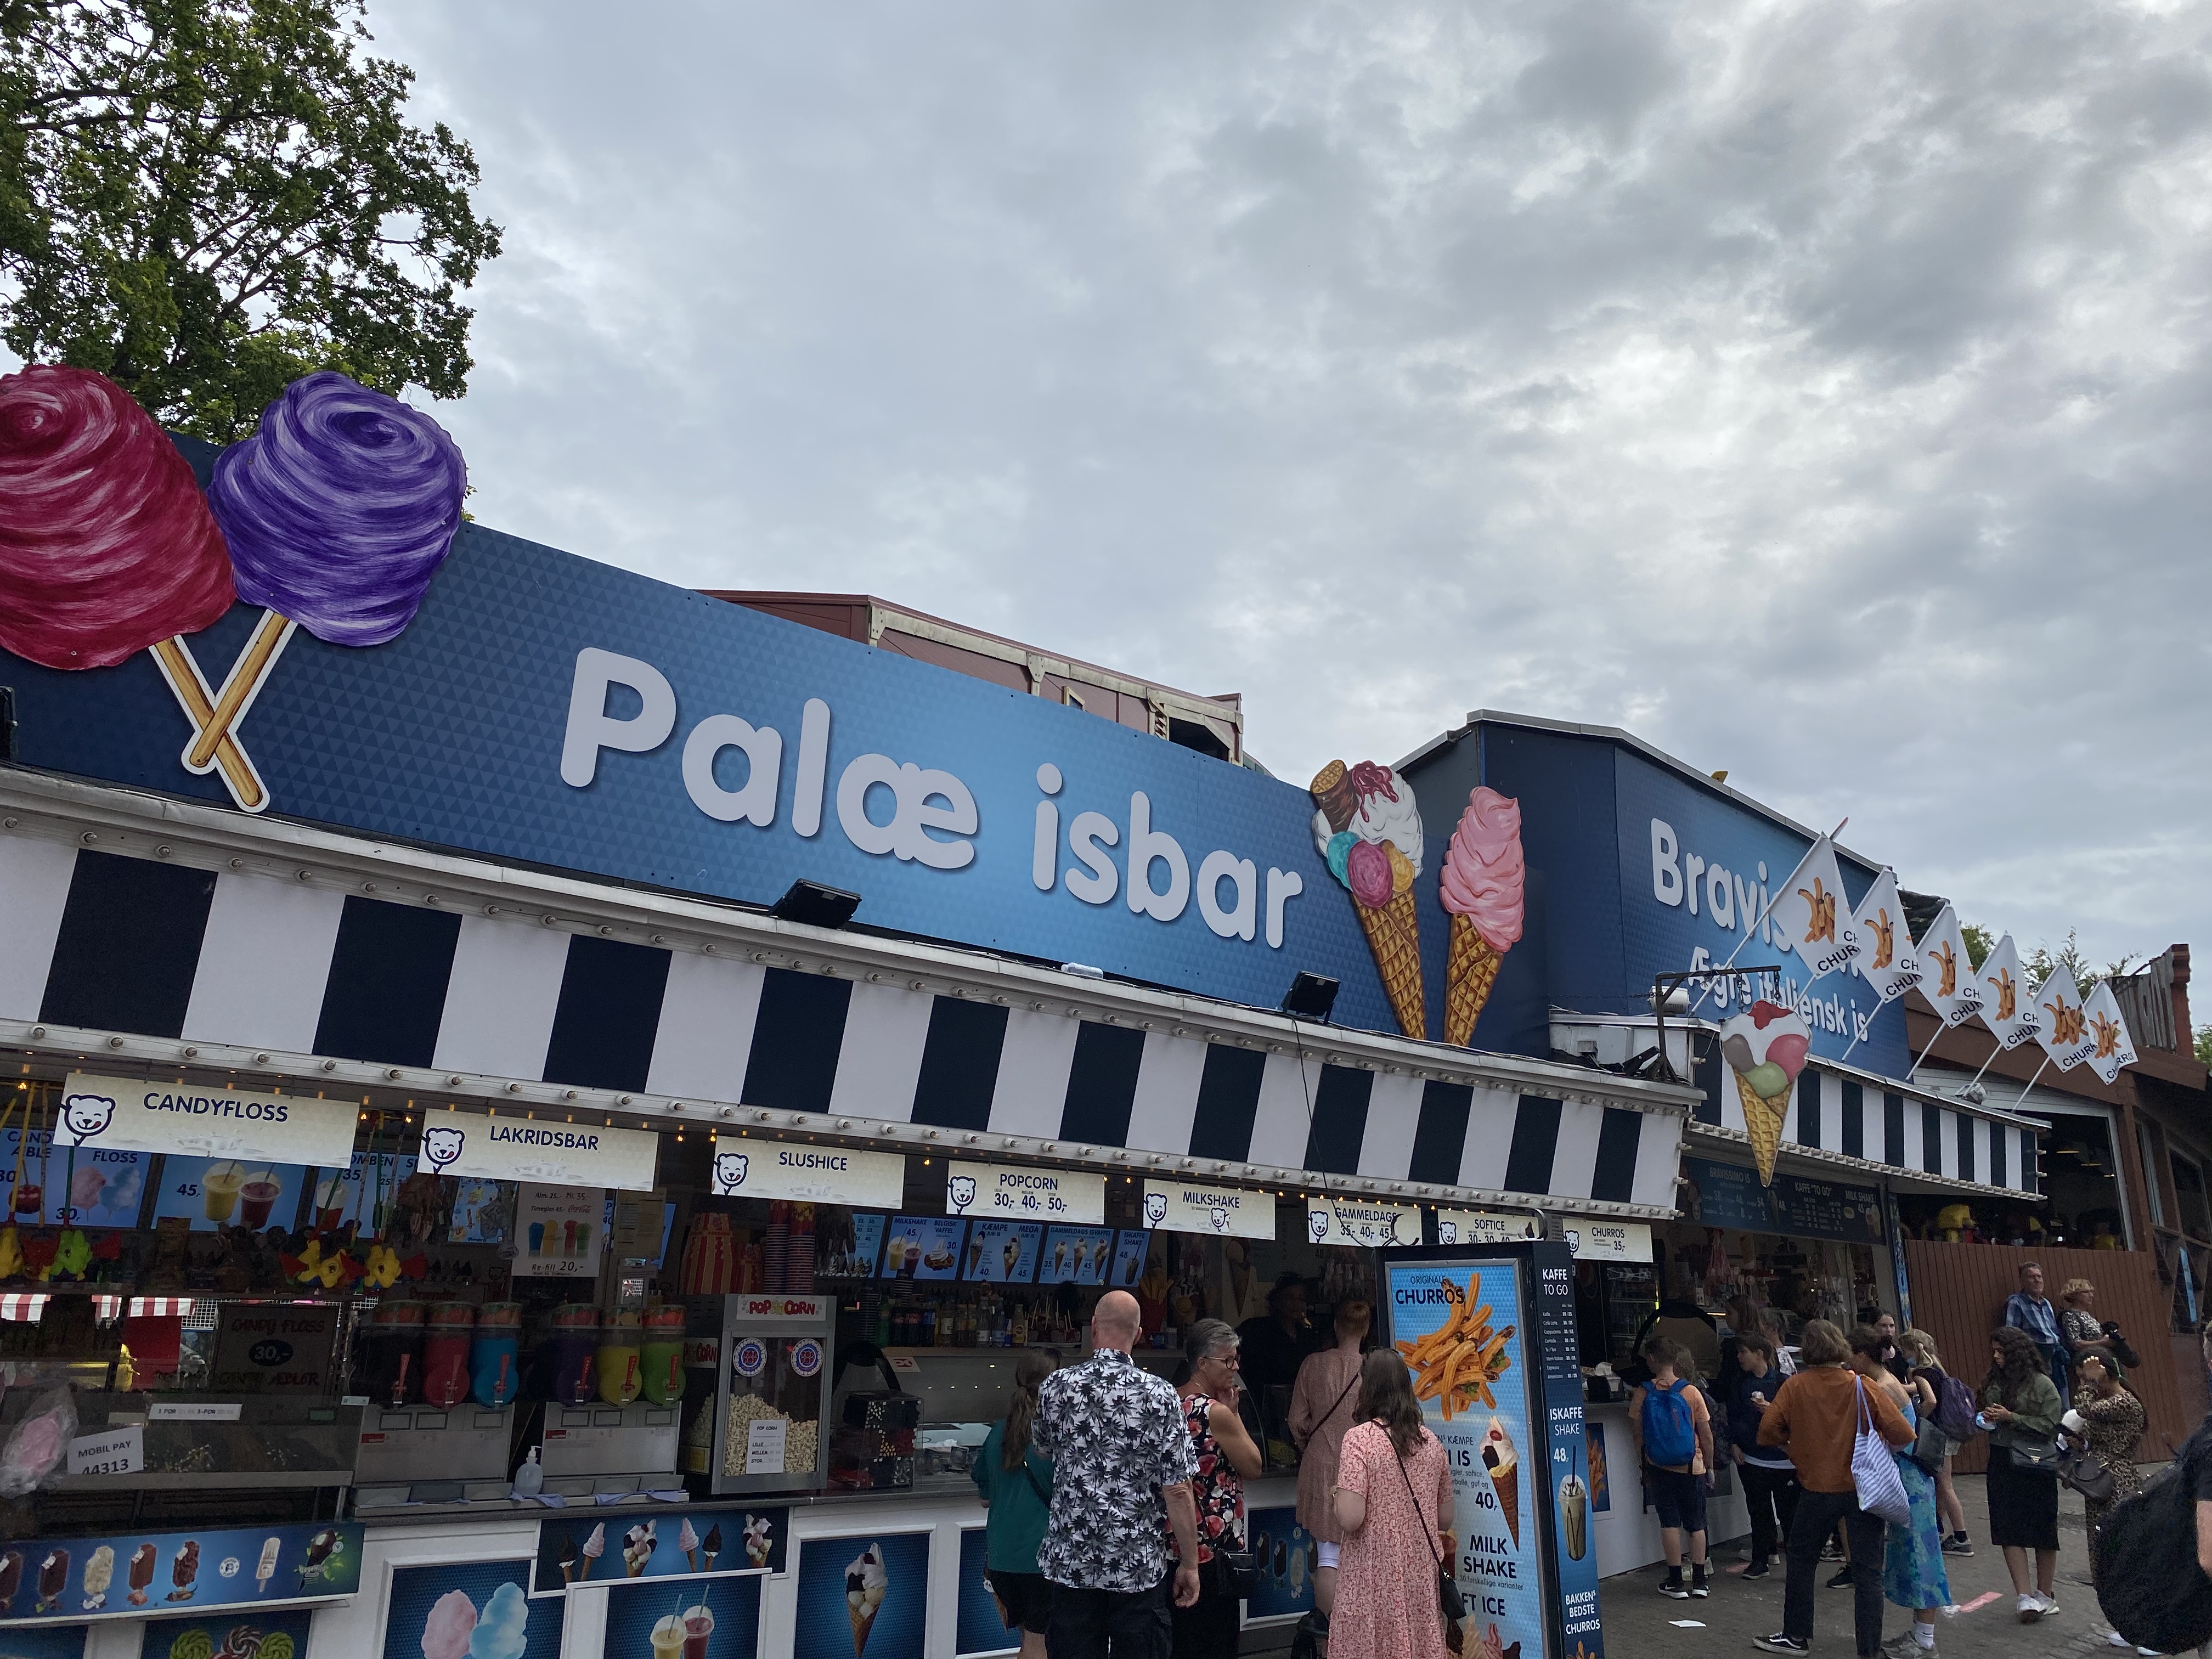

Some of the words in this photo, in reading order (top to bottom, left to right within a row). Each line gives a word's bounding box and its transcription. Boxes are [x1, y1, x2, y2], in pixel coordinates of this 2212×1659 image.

[560, 647, 979, 870] Palæ
[1032, 763, 1303, 949] isbar
[1818, 945, 1860, 972] CHUR
[1886, 973, 1923, 996] CHUR
[1850, 998, 1868, 1042] is
[144, 1092, 289, 1122] CANDYFLOSS
[490, 1125, 599, 1151] LAKRIDSBAR
[93, 1150, 138, 1164] FLOSS
[778, 1152, 848, 1171] SLUSHICE
[1000, 1173, 1058, 1190] POPCORN
[1709, 1166, 1743, 1183] BRAVISSIMO
[994, 1193, 1014, 1209] 30,-
[1022, 1195, 1041, 1211] 40,-
[1048, 1197, 1067, 1213] 50,-
[1183, 1191, 1239, 1208] MILKSHAKE
[1845, 1190, 1858, 1200] MILK
[982, 1223, 1008, 1231] KÆMPE
[1475, 1219, 1505, 1231] SOFTICE
[1592, 1227, 1625, 1238] CHURROS
[1542, 1268, 1567, 1280] KAFFE
[1395, 1289, 1464, 1305] CHURROS
[1543, 1284, 1554, 1295] TO
[1556, 1284, 1568, 1295] GO
[749, 1300, 771, 1314] POP
[1549, 1407, 1583, 1420] ISKAFFE
[1555, 1423, 1580, 1436] SHAKE
[78, 1445, 110, 1458] MOBIL
[113, 1440, 132, 1451] PAY
[1447, 1435, 1474, 1446] KÆMPE
[1458, 1449, 1470, 1466] IS
[1470, 1534, 1508, 1555] MILK
[1464, 1556, 1517, 1579] SHAKE
[1467, 1576, 1496, 1587] forskellige
[1497, 1582, 1523, 1590] varianter
[1461, 1592, 1476, 1611] FT
[1482, 1596, 1505, 1616] ICE
[1569, 1604, 1595, 1618] BEDSTE
[1566, 1618, 1600, 1634] CHURROS
